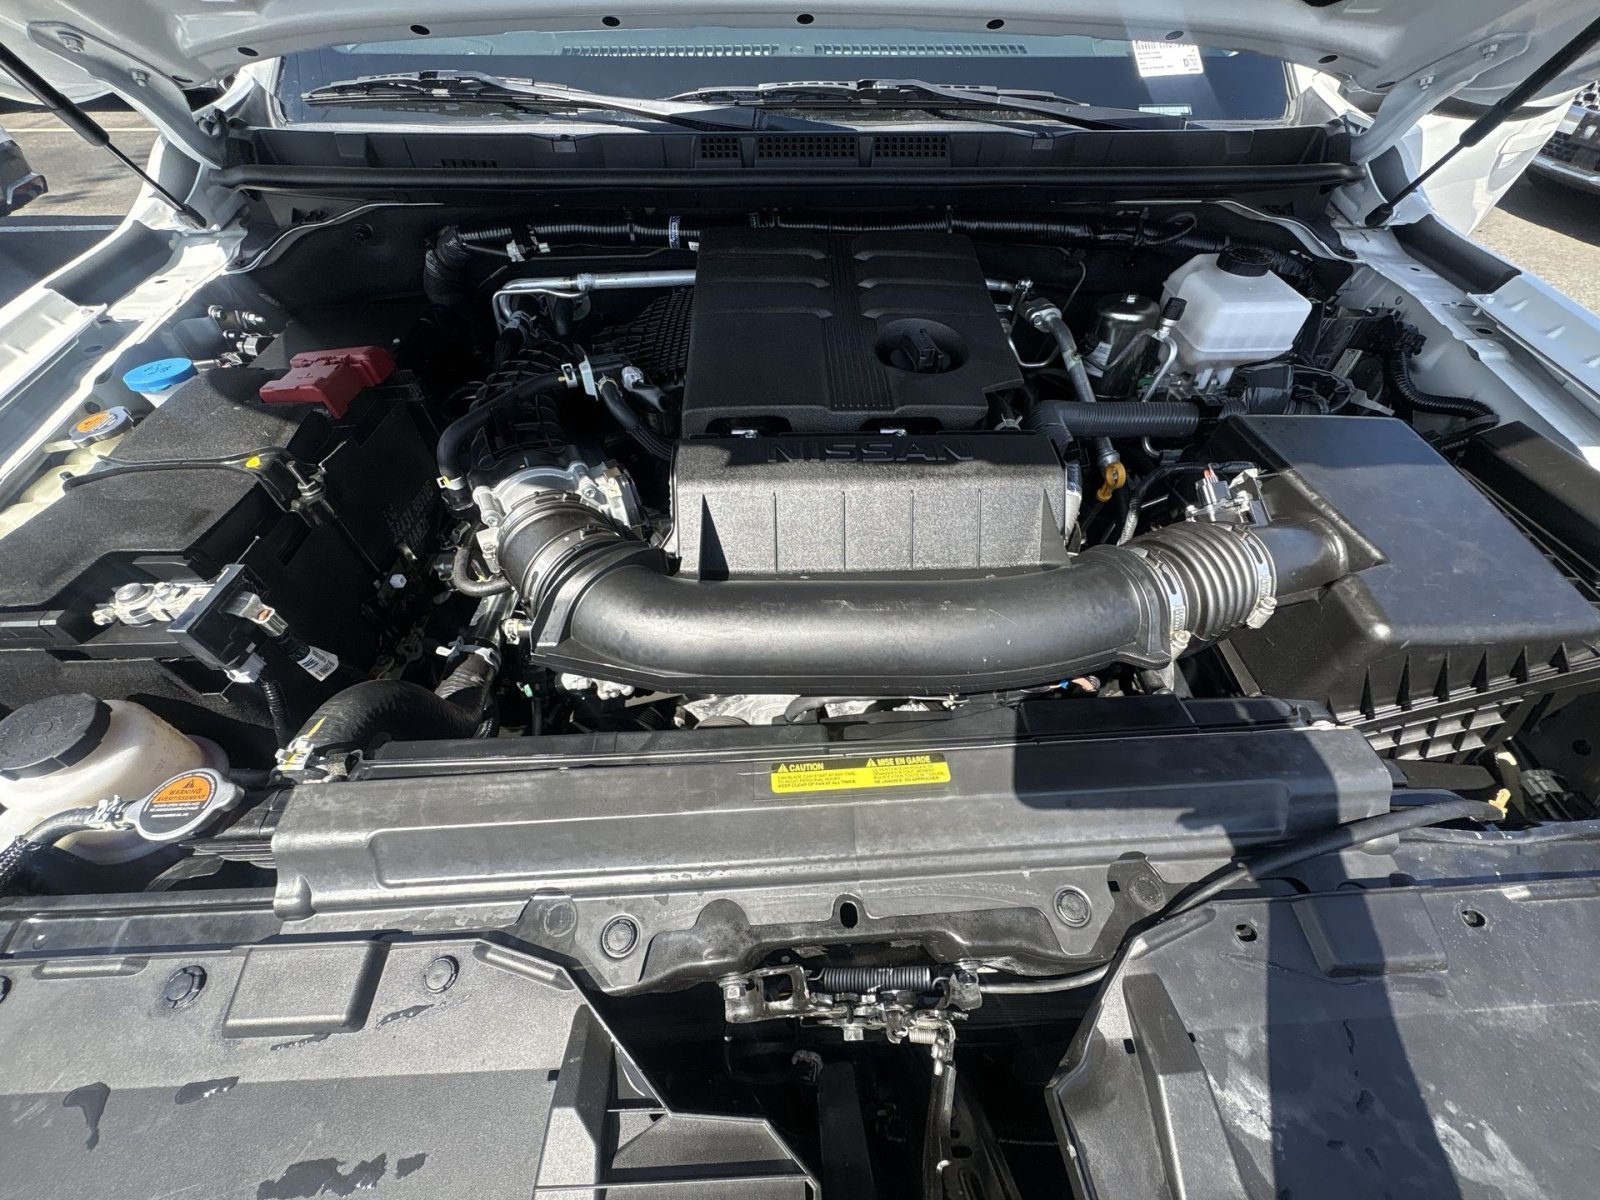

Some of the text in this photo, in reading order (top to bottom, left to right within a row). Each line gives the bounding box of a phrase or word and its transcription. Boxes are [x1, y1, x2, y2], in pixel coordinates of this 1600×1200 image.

[768, 442, 974, 462] NISSAN
[877, 755, 931, 766] MISE EN GARDE
[789, 762, 824, 772] CAUTION
